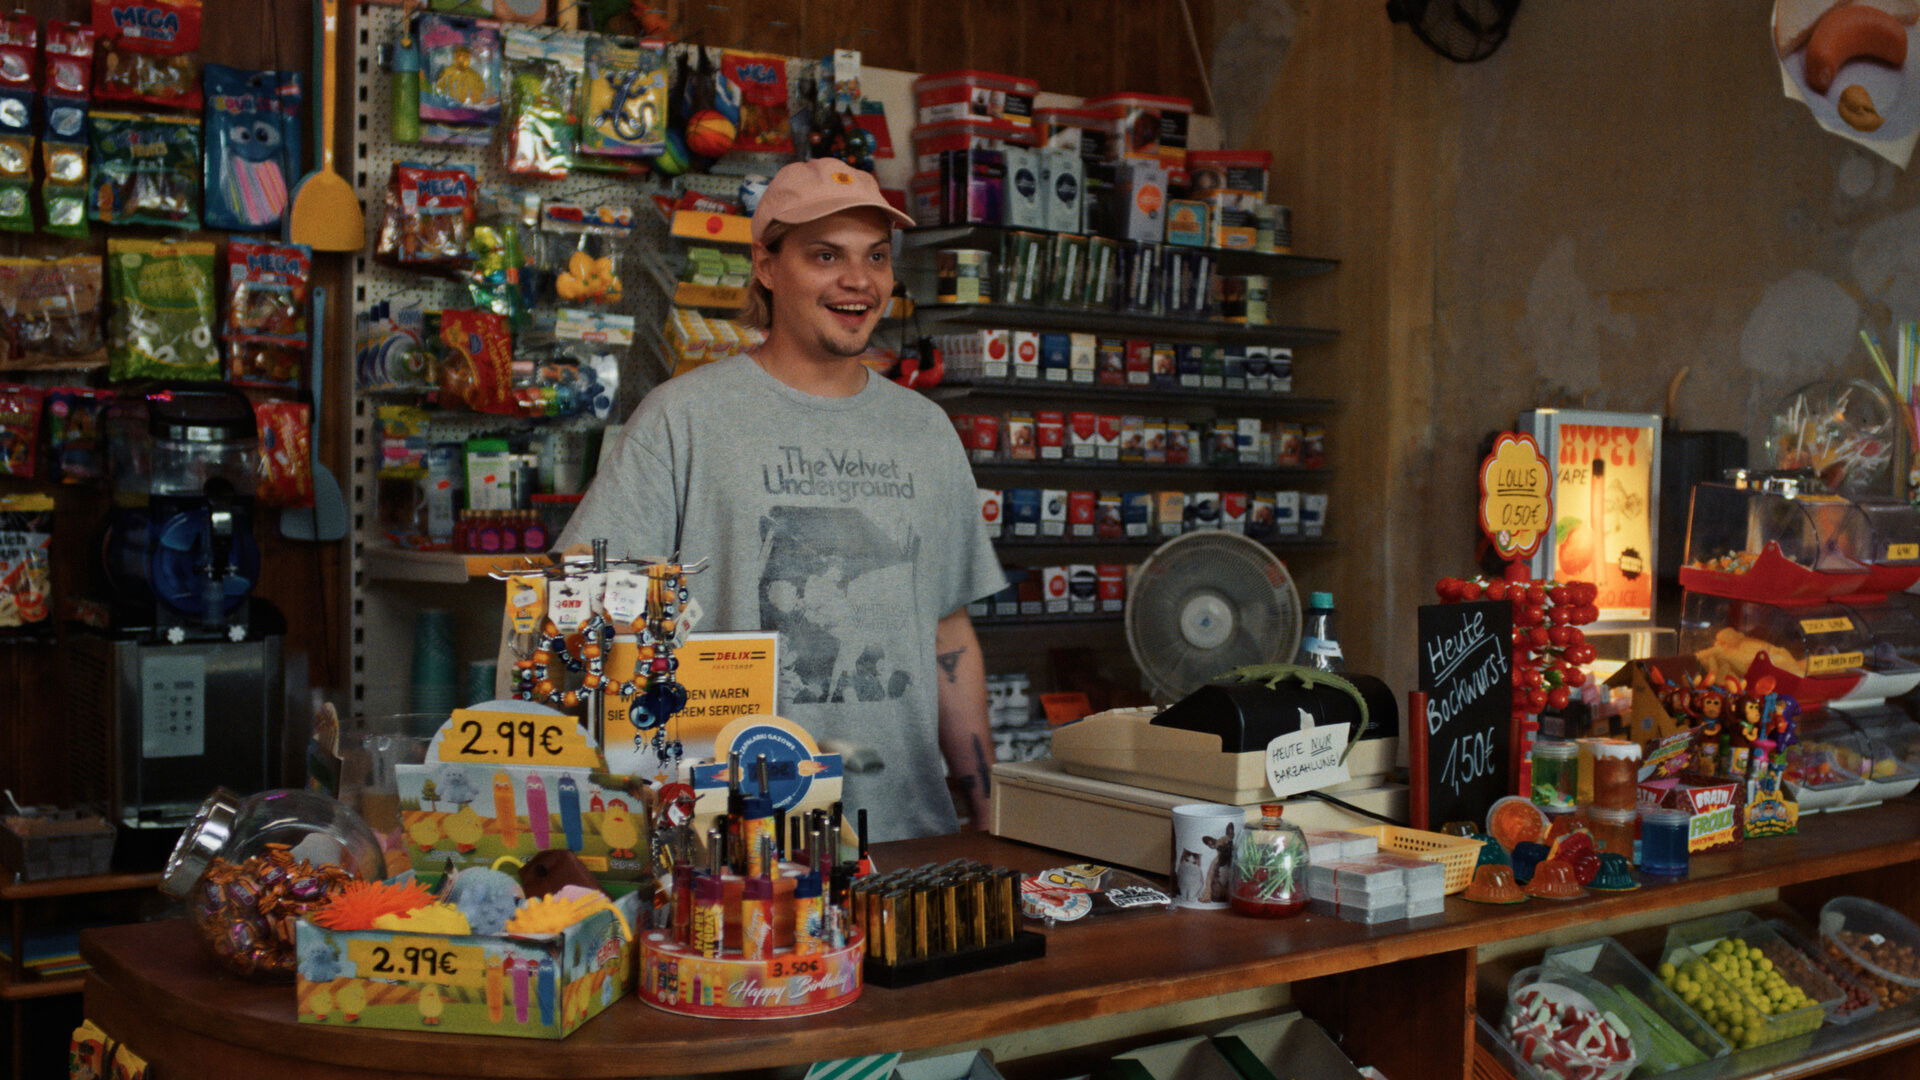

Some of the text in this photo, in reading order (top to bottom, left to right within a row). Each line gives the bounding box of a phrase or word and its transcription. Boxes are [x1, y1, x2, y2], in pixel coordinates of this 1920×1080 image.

[416, 178, 467, 198] MEGA
[779, 446, 900, 480] The Velvet
[763, 464, 915, 502] Underground
[1497, 468, 1538, 489] LOLLIS
[714, 651, 751, 661] DELIX
[1428, 611, 1485, 674] Heute
[709, 688, 749, 699] WAREN
[1426, 635, 1508, 736] Bockwurst
[607, 710, 625, 720] SIE
[709, 704, 760, 717] SERVICE?
[460, 720, 563, 757] 2.99€
[1272, 733, 1332, 761] HEUTE NUR
[1441, 727, 1495, 796] 1,50€
[1695, 788, 1730, 809] BRAIN
[1690, 807, 1734, 838] FROXX
[372, 946, 458, 976] 2.99€
[772, 960, 818, 978] 3.50€
[727, 970, 850, 1006] Happy Birthday
